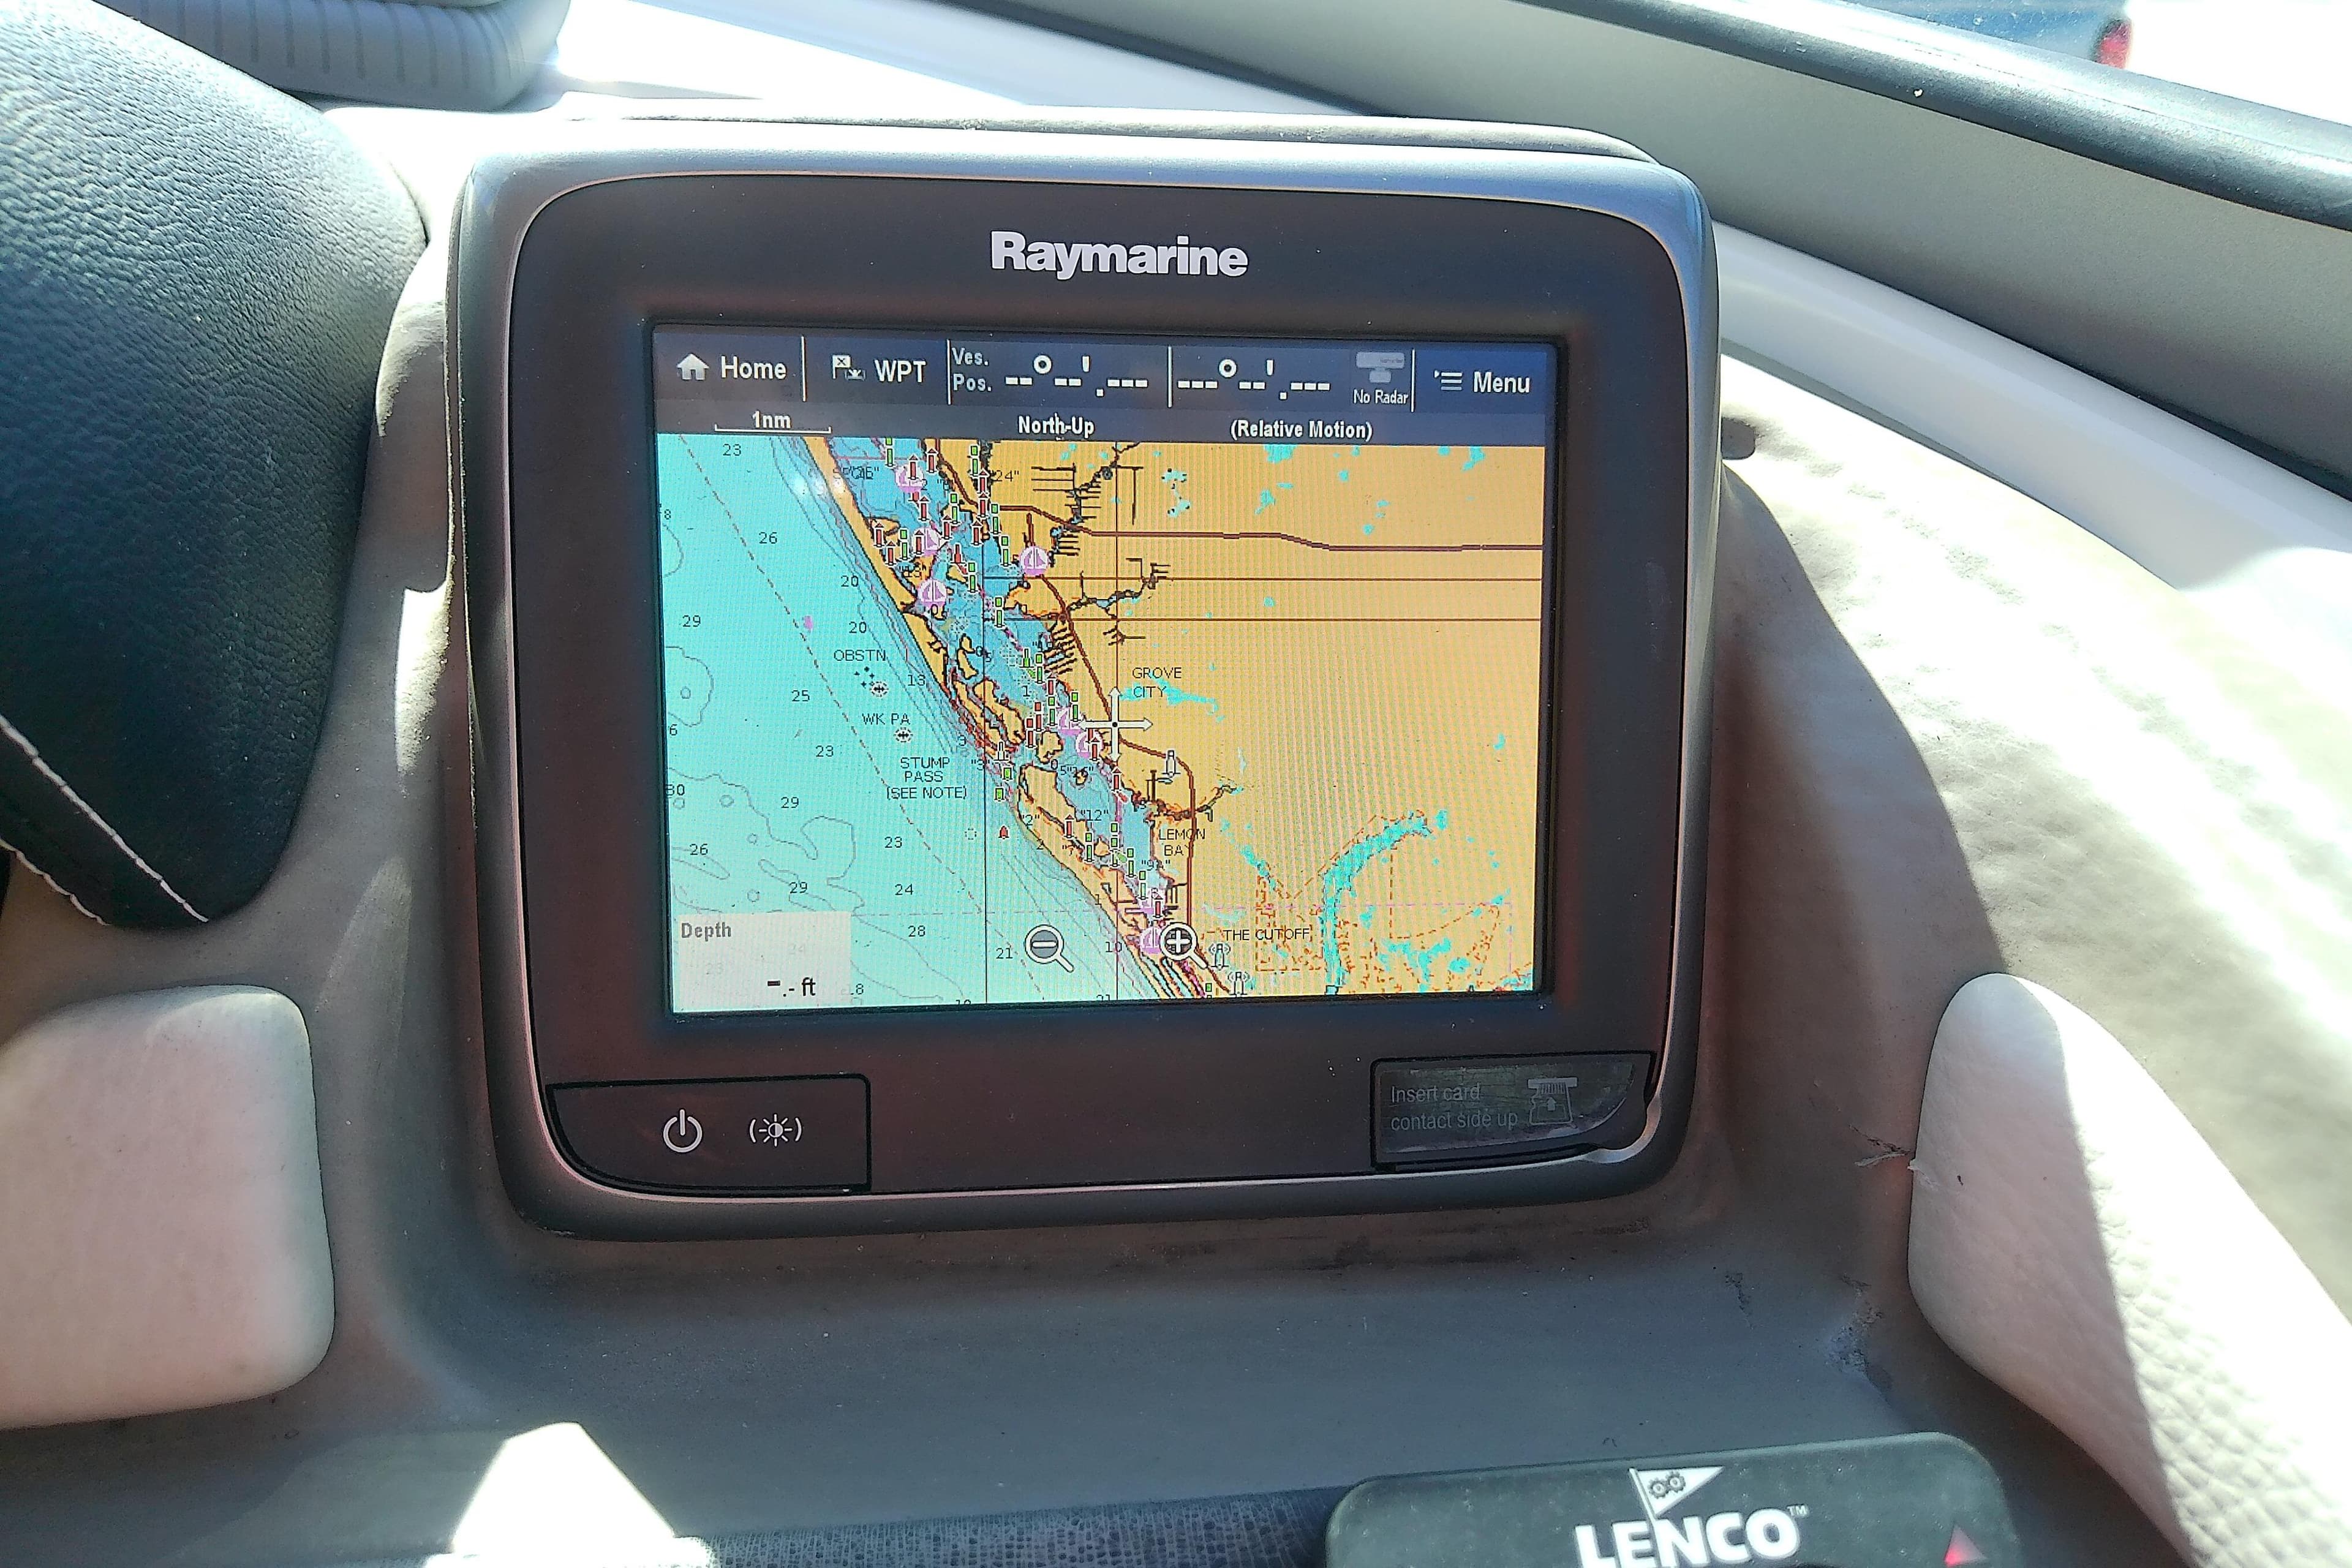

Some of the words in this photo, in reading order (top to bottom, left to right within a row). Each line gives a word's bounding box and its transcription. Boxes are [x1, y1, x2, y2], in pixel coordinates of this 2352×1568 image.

[990, 230, 1248, 281] Raymarine
[952, 347, 989, 366] Ves.
[720, 355, 787, 380] Home
[874, 360, 926, 383] WPT
[952, 374, 992, 393] Pos.
[1472, 371, 1531, 394] Menu
[1353, 388, 1371, 404] No
[1374, 388, 1409, 404] Radar
[751, 410, 791, 429] 1nm
[1018, 415, 1095, 437] North-Up
[1230, 418, 1304, 440] (Relative
[1308, 421, 1373, 441] Motion)
[722, 443, 742, 456] 23
[758, 532, 778, 545] 26
[841, 575, 859, 587] 20
[682, 615, 701, 627] 29
[849, 622, 867, 633] 20
[834, 649, 886, 662] OBSTN
[1132, 667, 1182, 679] GROVE
[791, 690, 810, 702] 25
[1133, 686, 1167, 698] CITY
[862, 713, 885, 725] WK
[891, 713, 911, 725] PA
[815, 745, 834, 757] 23
[900, 756, 950, 769] STUMP
[905, 771, 944, 783] PASS
[887, 786, 917, 799] (SEE
[922, 786, 967, 799] NOTE)
[781, 797, 799, 809] 29
[1159, 828, 1206, 840] LEMON
[884, 837, 902, 848] 23
[689, 843, 708, 856] 26
[1164, 845, 1193, 856] BAY
[790, 882, 807, 894] 29
[895, 884, 913, 895] 24
[681, 922, 732, 941] Depth
[908, 925, 926, 937] 28
[1225, 929, 1251, 941] THE
[1255, 928, 1310, 940] CUTOFF
[996, 948, 1013, 959] 21
[801, 976, 816, 997] ft
[1391, 1085, 1439, 1104] Insert
[1442, 1082, 1481, 1101] card
[1390, 1114, 1451, 1131] contact
[1457, 1111, 1493, 1129] side
[1496, 1111, 1519, 1129] up
[1575, 1507, 1799, 1568] LENCO
